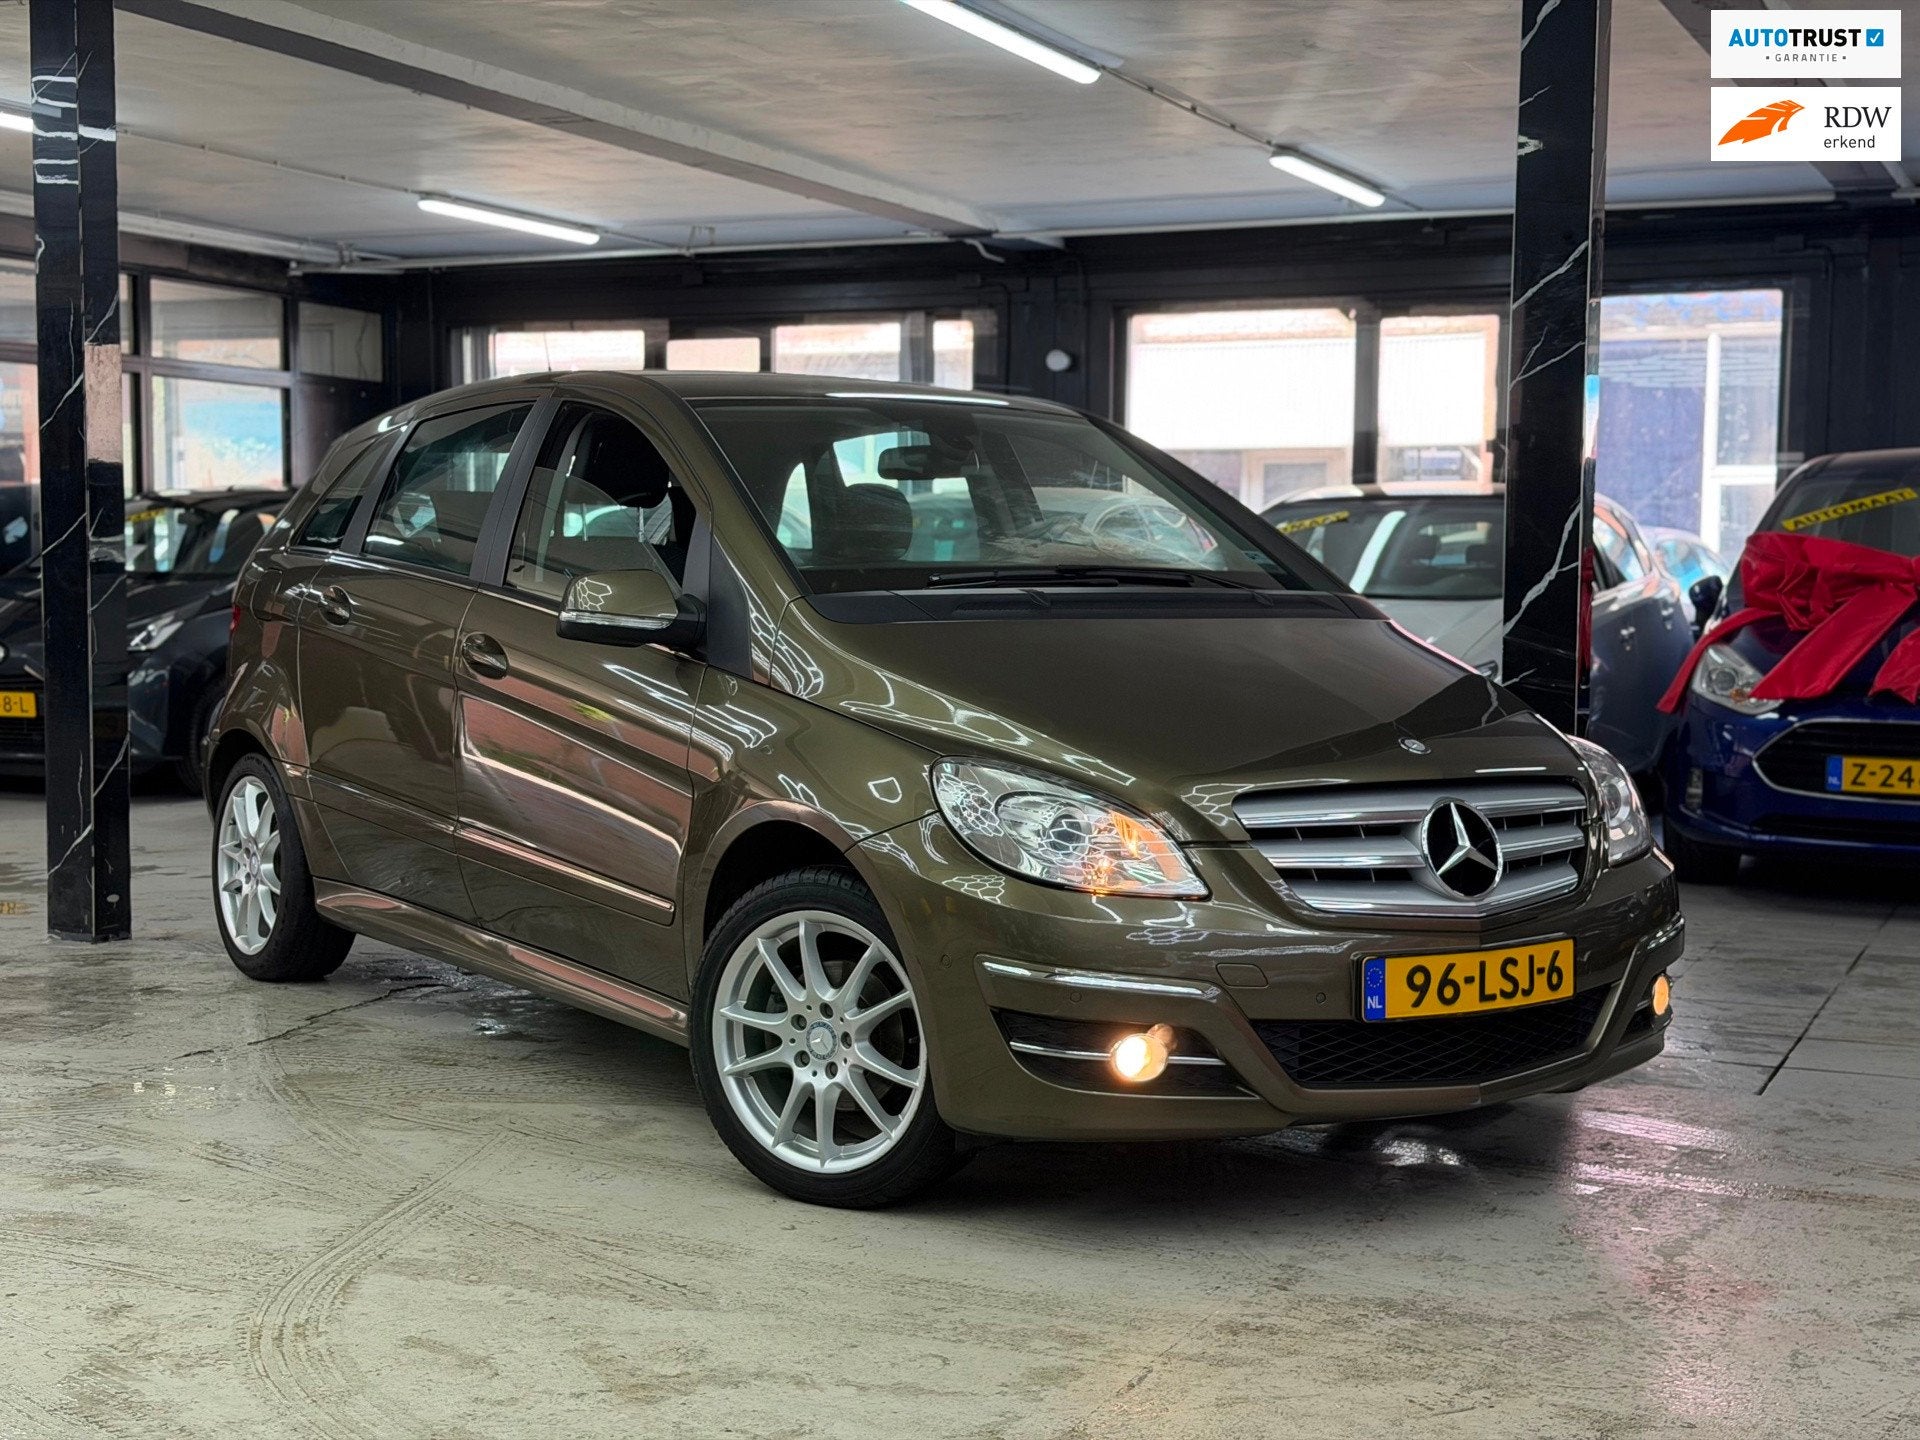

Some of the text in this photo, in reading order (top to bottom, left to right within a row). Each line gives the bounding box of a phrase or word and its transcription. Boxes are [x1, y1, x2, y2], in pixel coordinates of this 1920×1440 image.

[1792, 490, 1908, 529] AUTOMAAT
[0, 695, 29, 713] 8-L
[1827, 776, 1840, 785] NL
[1851, 763, 1920, 788] Z-24
[1406, 950, 1564, 1008] 96-LSJ-6
[1367, 995, 1383, 1009] NL
